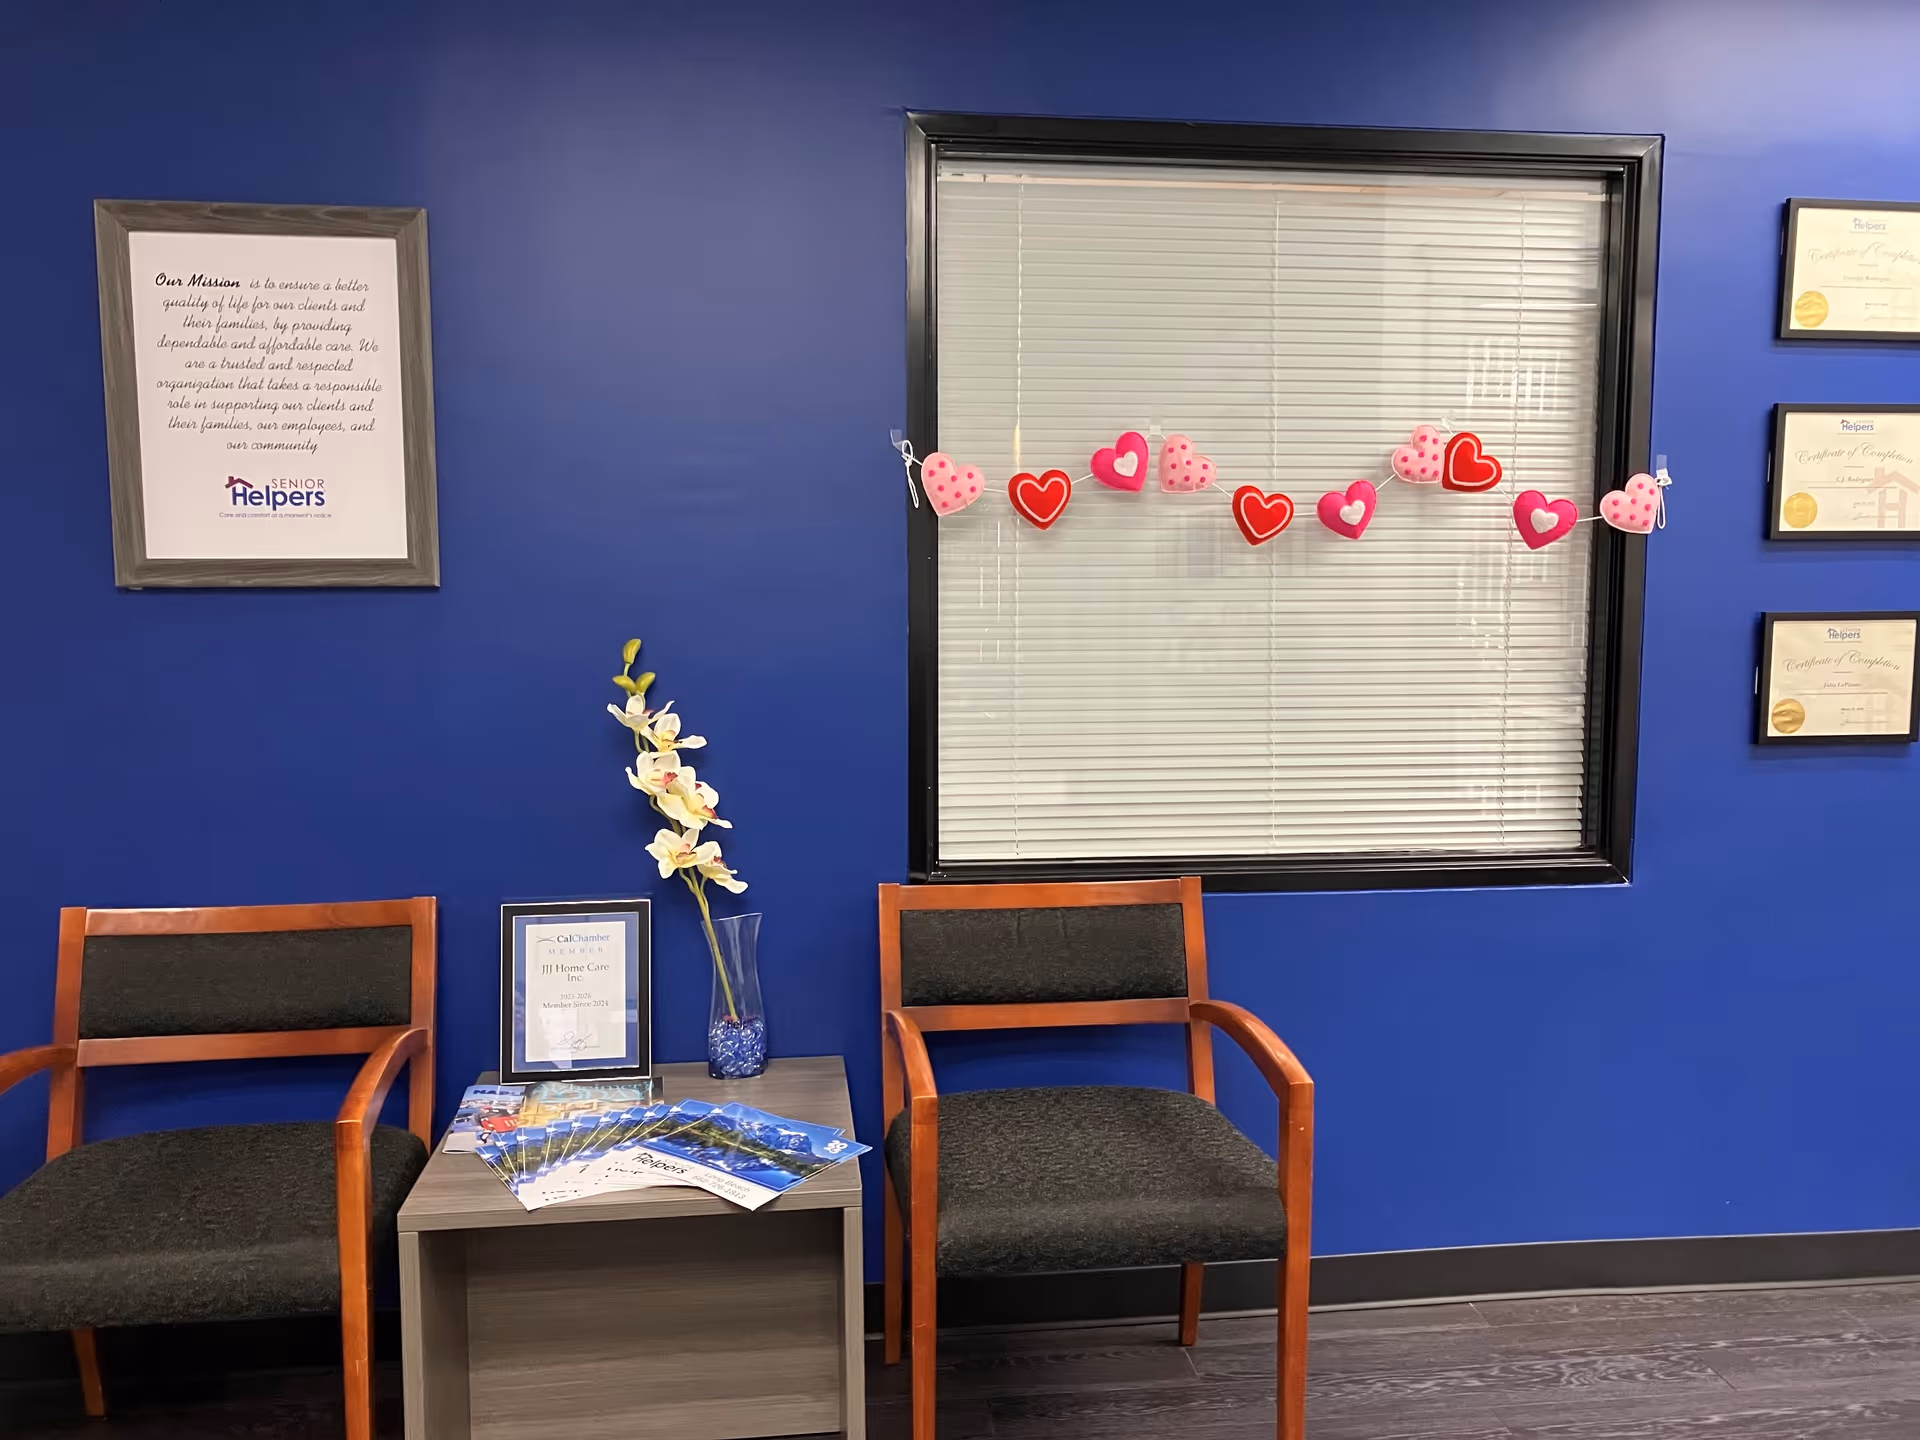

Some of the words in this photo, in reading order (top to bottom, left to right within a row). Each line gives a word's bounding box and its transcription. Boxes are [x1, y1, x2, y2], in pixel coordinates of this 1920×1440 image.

[155, 272, 183, 287] Our
[187, 273, 240, 287] Mission
[249, 279, 260, 288] is
[264, 276, 276, 289] to
[279, 280, 320, 290] ensure
[322, 283, 331, 291] a
[335, 278, 369, 291] better
[162, 294, 209, 312] quality
[212, 295, 224, 313] of
[228, 295, 249, 313] life
[252, 296, 270, 314] for
[273, 301, 294, 310] our
[298, 297, 338, 311] clients
[341, 298, 366, 311] and
[183, 314, 212, 328] their
[215, 315, 268, 333] families,
[273, 316, 288, 335] by
[291, 317, 352, 336] providing
[157, 334, 228, 352] dependable
[231, 336, 256, 349] and
[259, 336, 322, 355] affordable
[325, 343, 353, 352] care.
[359, 338, 379, 352] We
[185, 360, 205, 369] are
[208, 360, 217, 369] a
[221, 356, 265, 370] trusted
[268, 356, 293, 370] and
[296, 358, 353, 376] respected
[157, 376, 234, 393] organization
[238, 376, 264, 390] that
[267, 376, 299, 391] takes
[302, 383, 311, 391] a
[314, 378, 382, 395] responsible
[167, 395, 191, 409] role
[194, 399, 207, 409] in
[211, 396, 279, 415] supporting
[282, 402, 303, 411] our
[307, 397, 346, 411] clients
[349, 398, 374, 411] and
[168, 415, 197, 429] their
[200, 415, 252, 434] families,
[257, 421, 278, 431] our
[281, 416, 345, 436] employees,
[350, 418, 375, 431] and
[1842, 422, 1874, 432] Helpers
[226, 441, 248, 450] our
[251, 438, 318, 455] community
[1795, 448, 1846, 464] Certificate
[1860, 442, 1914, 464] Completion
[271, 478, 325, 489] SENIOR
[231, 484, 325, 511] Helpers
[1829, 630, 1861, 640] Helpers
[1783, 655, 1834, 672] Certificate
[1846, 650, 1901, 671] Completion
[556, 933, 610, 943] CalChamber
[541, 964, 553, 975] JJJ
[555, 963, 585, 973] Home
[586, 962, 610, 972] Care
[567, 973, 584, 982] Inc.
[542, 1001, 572, 1009] Member
[572, 1000, 592, 1009] Since
[632, 1154, 688, 1175] Helpers
[704, 1172, 725, 1184] Long
[724, 1180, 751, 1194] Beach
